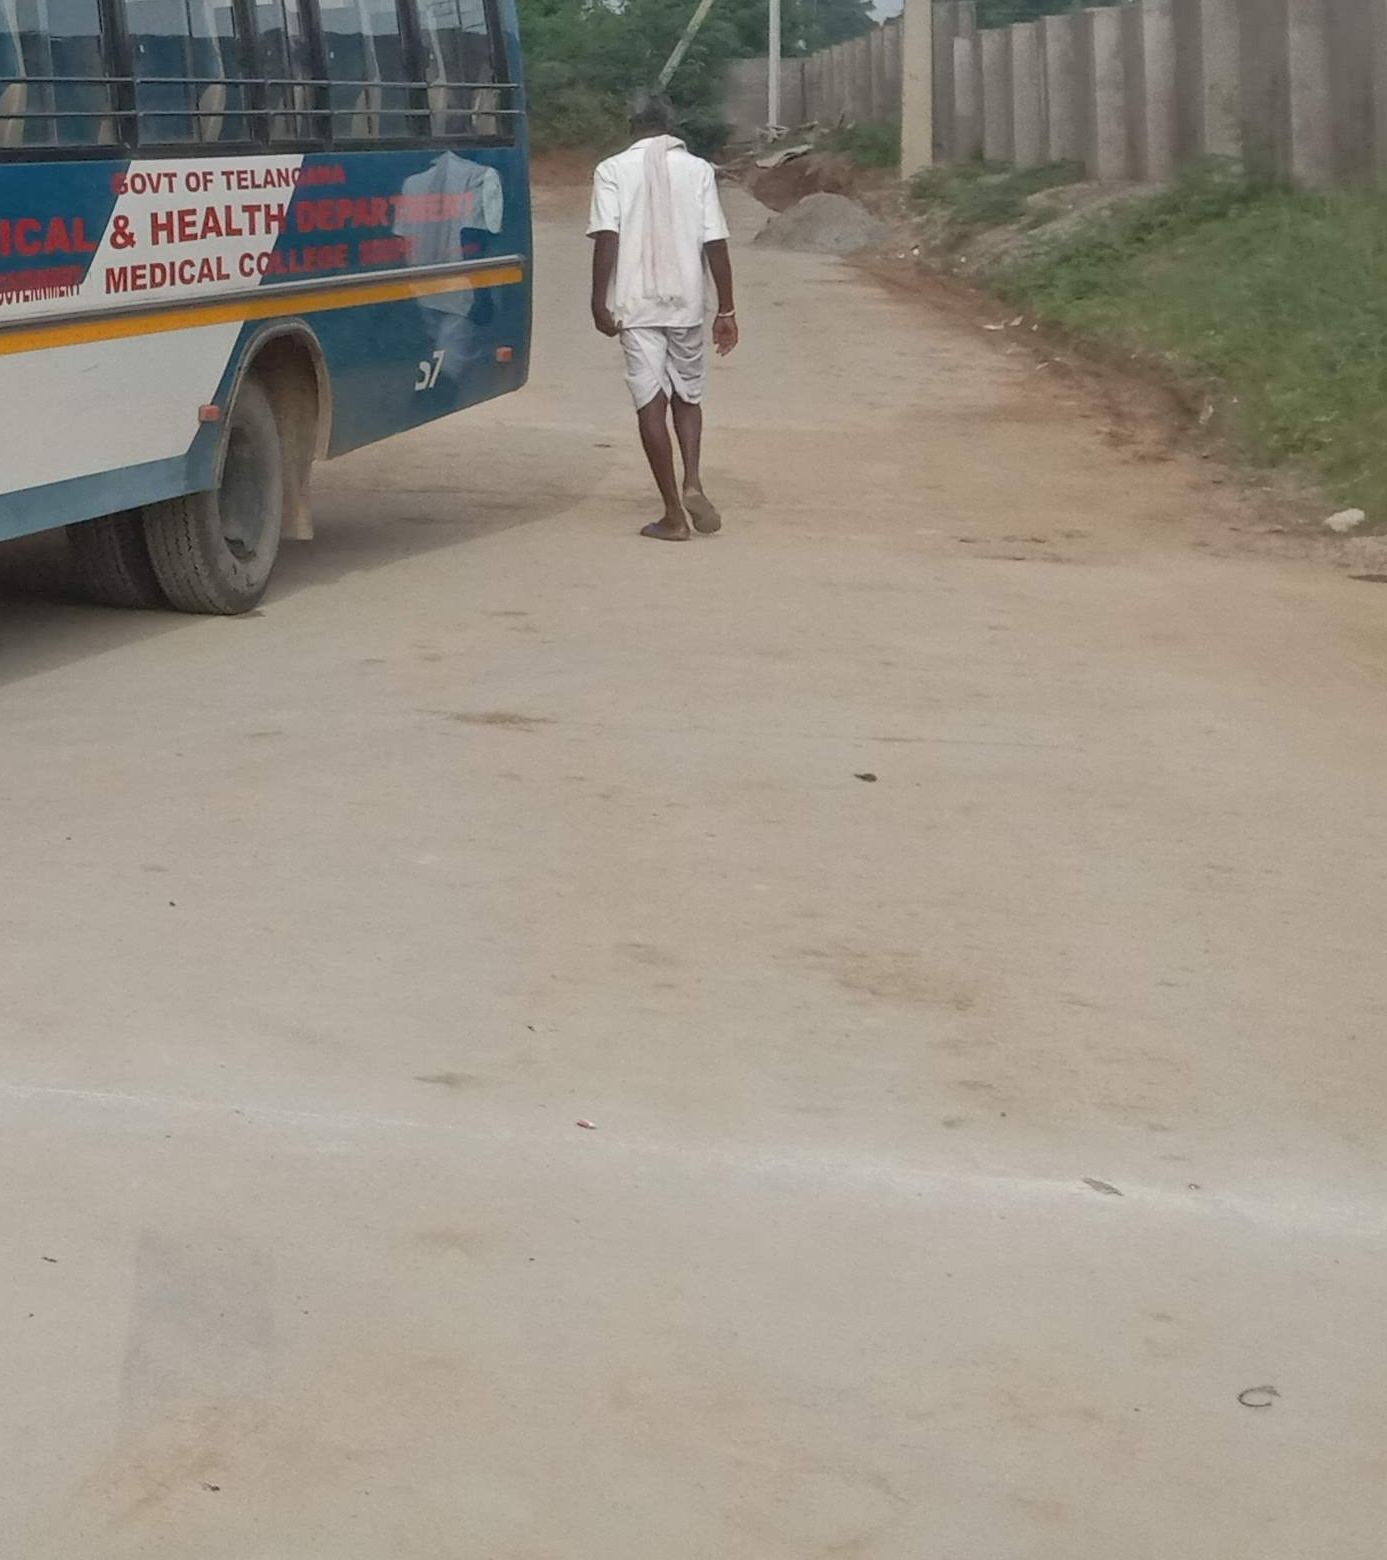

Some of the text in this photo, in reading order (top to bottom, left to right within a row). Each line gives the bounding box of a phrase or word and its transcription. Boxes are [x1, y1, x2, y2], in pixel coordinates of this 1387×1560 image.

[112, 172, 177, 195] GOVT
[185, 171, 214, 193] OF
[109, 215, 136, 249] &
[150, 202, 287, 246] HEALTH
[105, 253, 230, 295] MEDICAL
